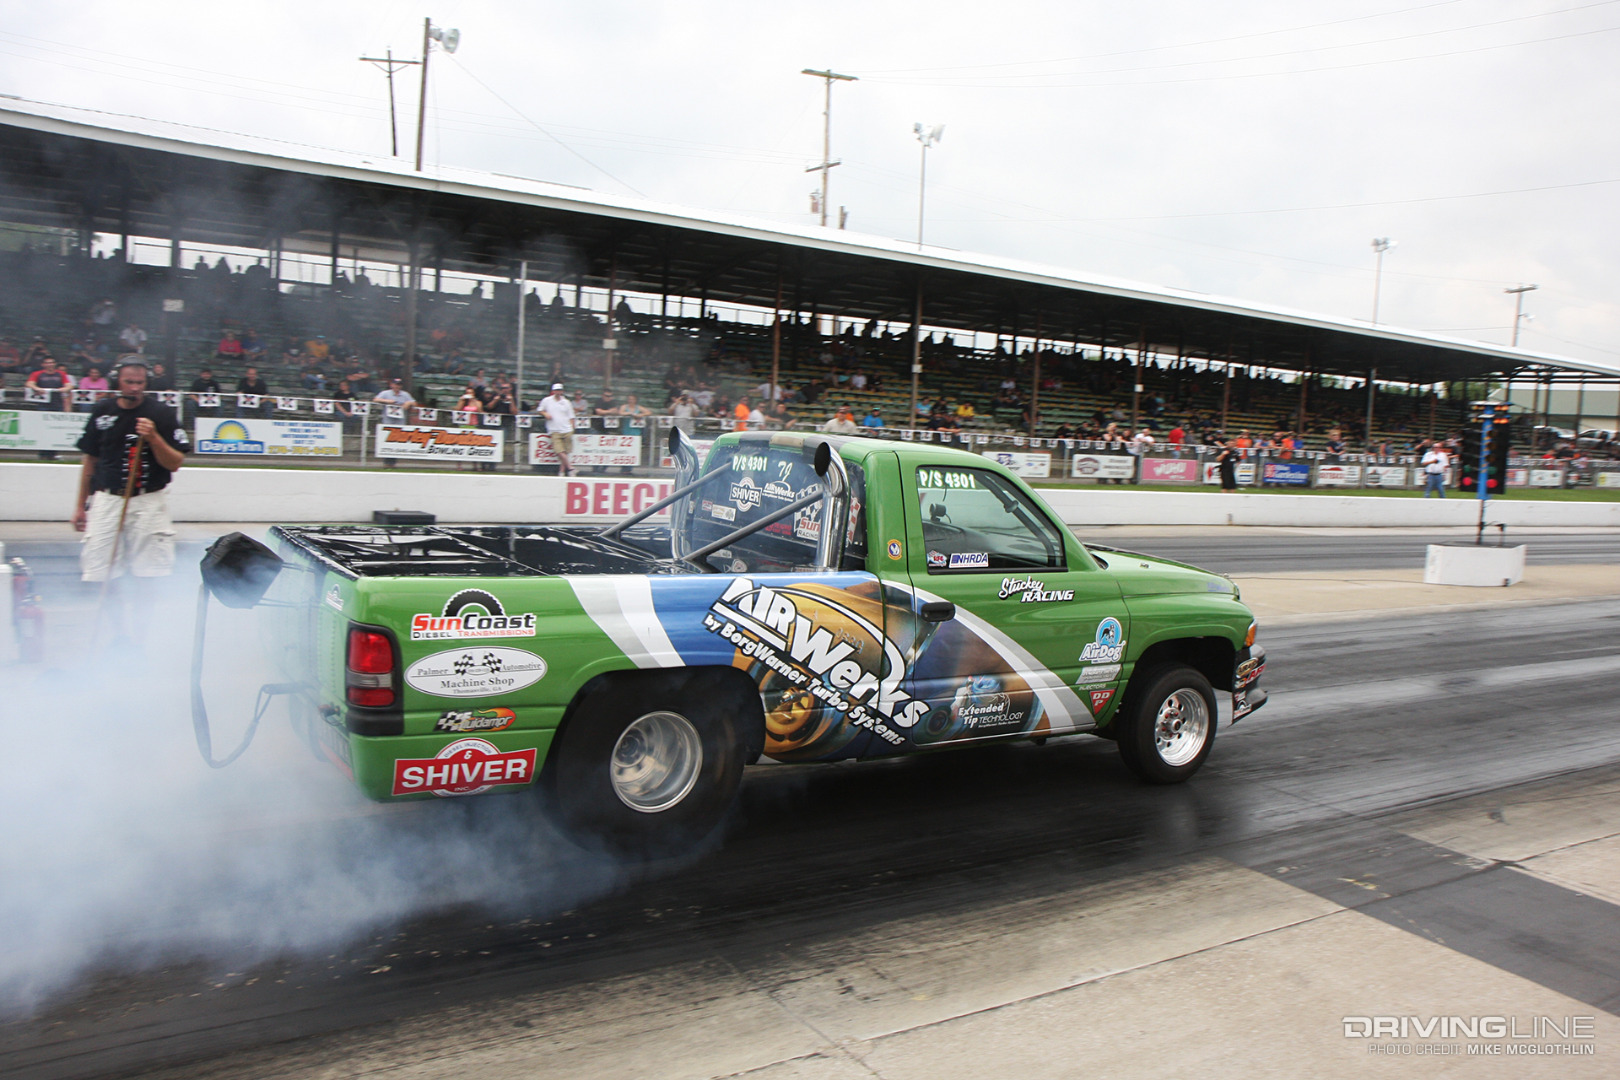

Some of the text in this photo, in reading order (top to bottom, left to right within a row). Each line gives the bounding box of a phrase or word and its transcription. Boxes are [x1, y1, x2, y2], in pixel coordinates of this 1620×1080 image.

[382, 427, 498, 448] Harley-Davidson
[619, 436, 634, 447] 22
[201, 441, 262, 453] Days Inn
[427, 446, 464, 455] BOWLING
[466, 447, 497, 456] GREEN
[732, 455, 768, 471] P/S 4301
[919, 469, 976, 488] P/S 4301
[731, 487, 760, 503] SHIVER
[954, 553, 988, 565] NHRDA
[999, 576, 1045, 599] Stuckey
[1020, 590, 1075, 602] RACING
[412, 613, 535, 632] SunCoast
[412, 629, 535, 639] DIESEL TRANSMISSIONS
[1080, 641, 1126, 662] AirDog
[417, 667, 449, 676] Palmer
[501, 662, 542, 672] Automotive
[440, 676, 515, 689] Machine Shop
[704, 614, 722, 632] by
[720, 624, 808, 685] BorgWarner
[806, 678, 850, 711] Turbo
[848, 705, 907, 746] Systems
[958, 702, 1005, 717] Extended
[963, 711, 1024, 728] Tip TECHNOLOGY
[463, 750, 473, 760] &
[401, 758, 529, 788] SHIVER
